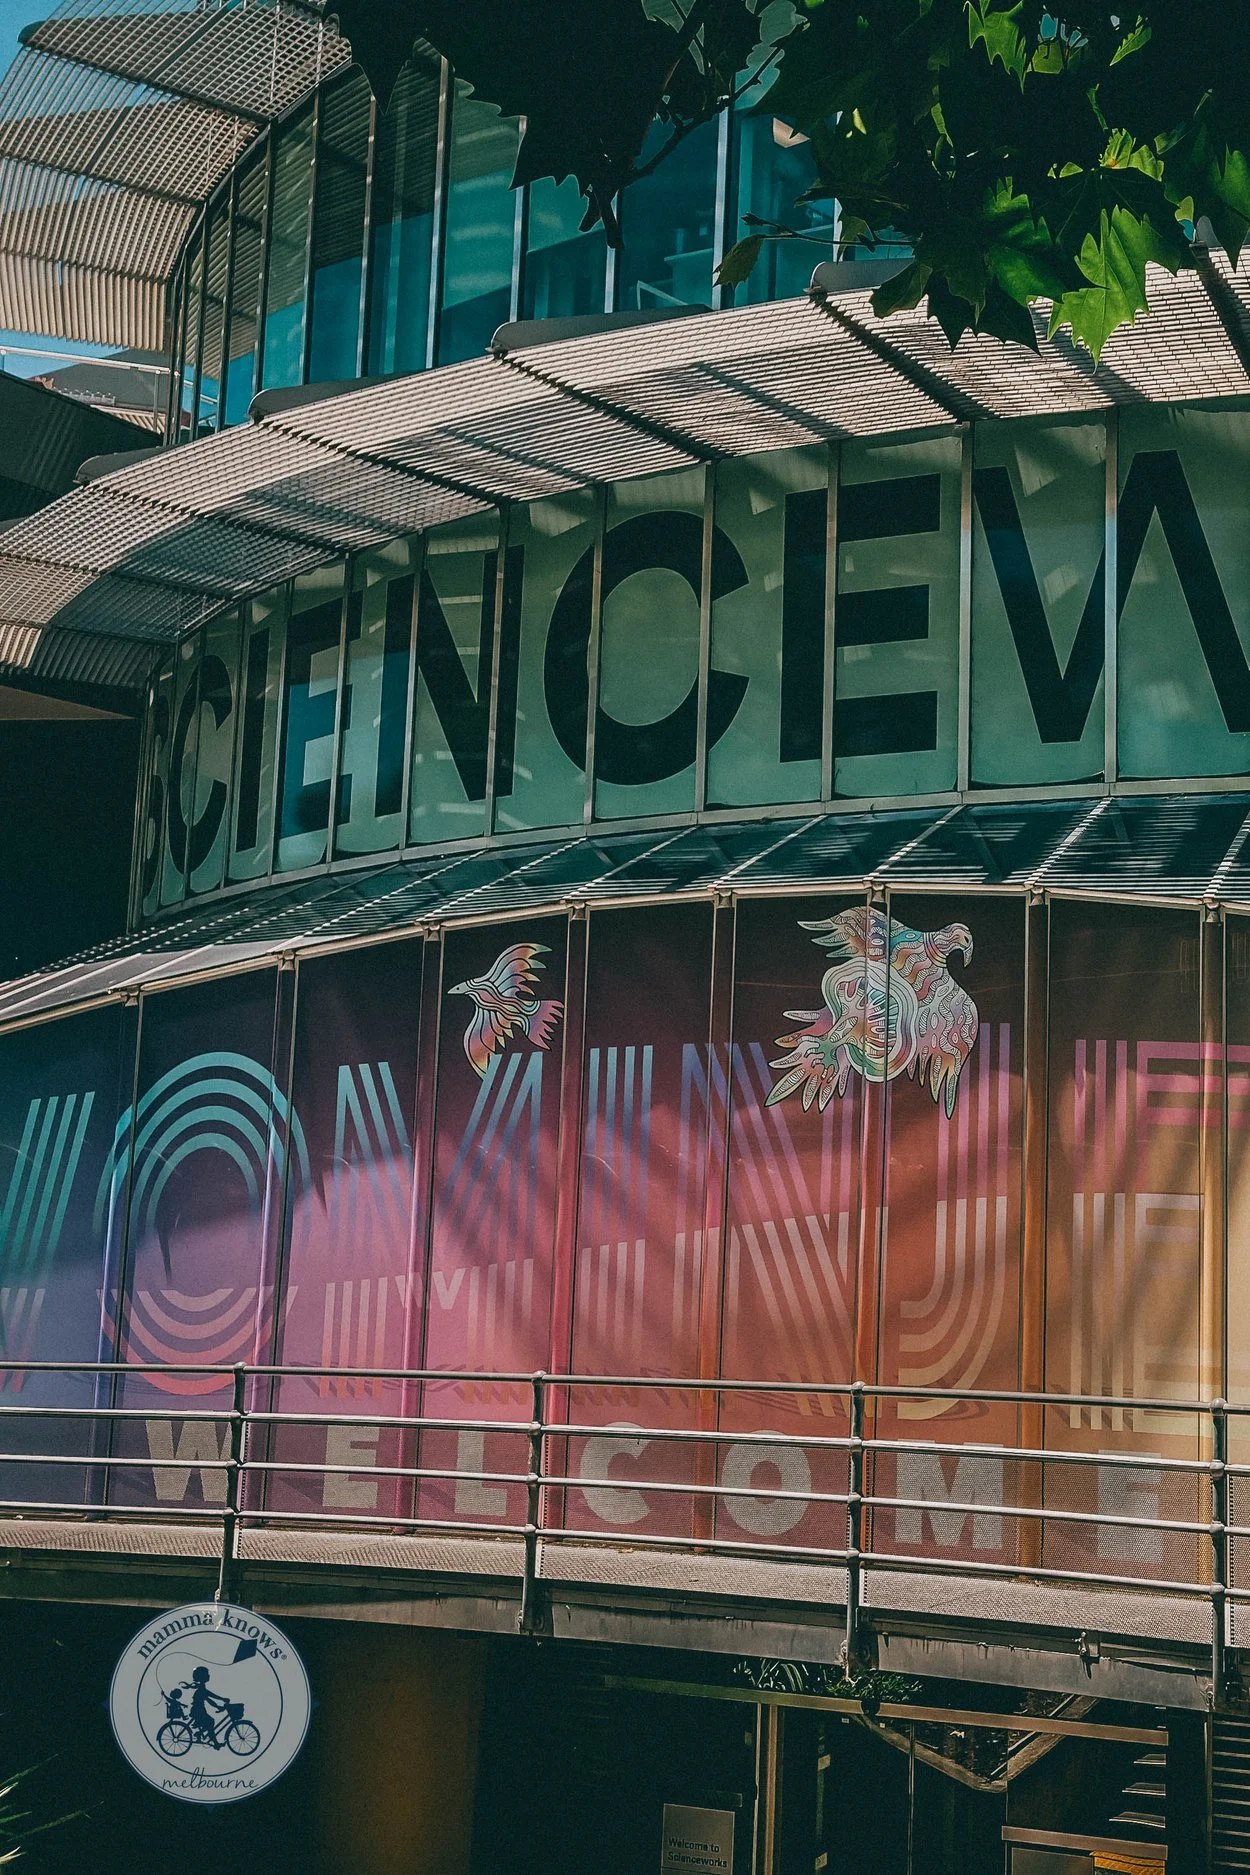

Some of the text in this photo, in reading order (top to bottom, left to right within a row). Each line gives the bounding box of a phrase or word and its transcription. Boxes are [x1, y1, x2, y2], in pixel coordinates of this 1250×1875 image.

[145, 1418, 1164, 1563] WELCOME
[668, 1837, 720, 1853] Welcome to
[667, 1851, 728, 1868] Scienceworks
